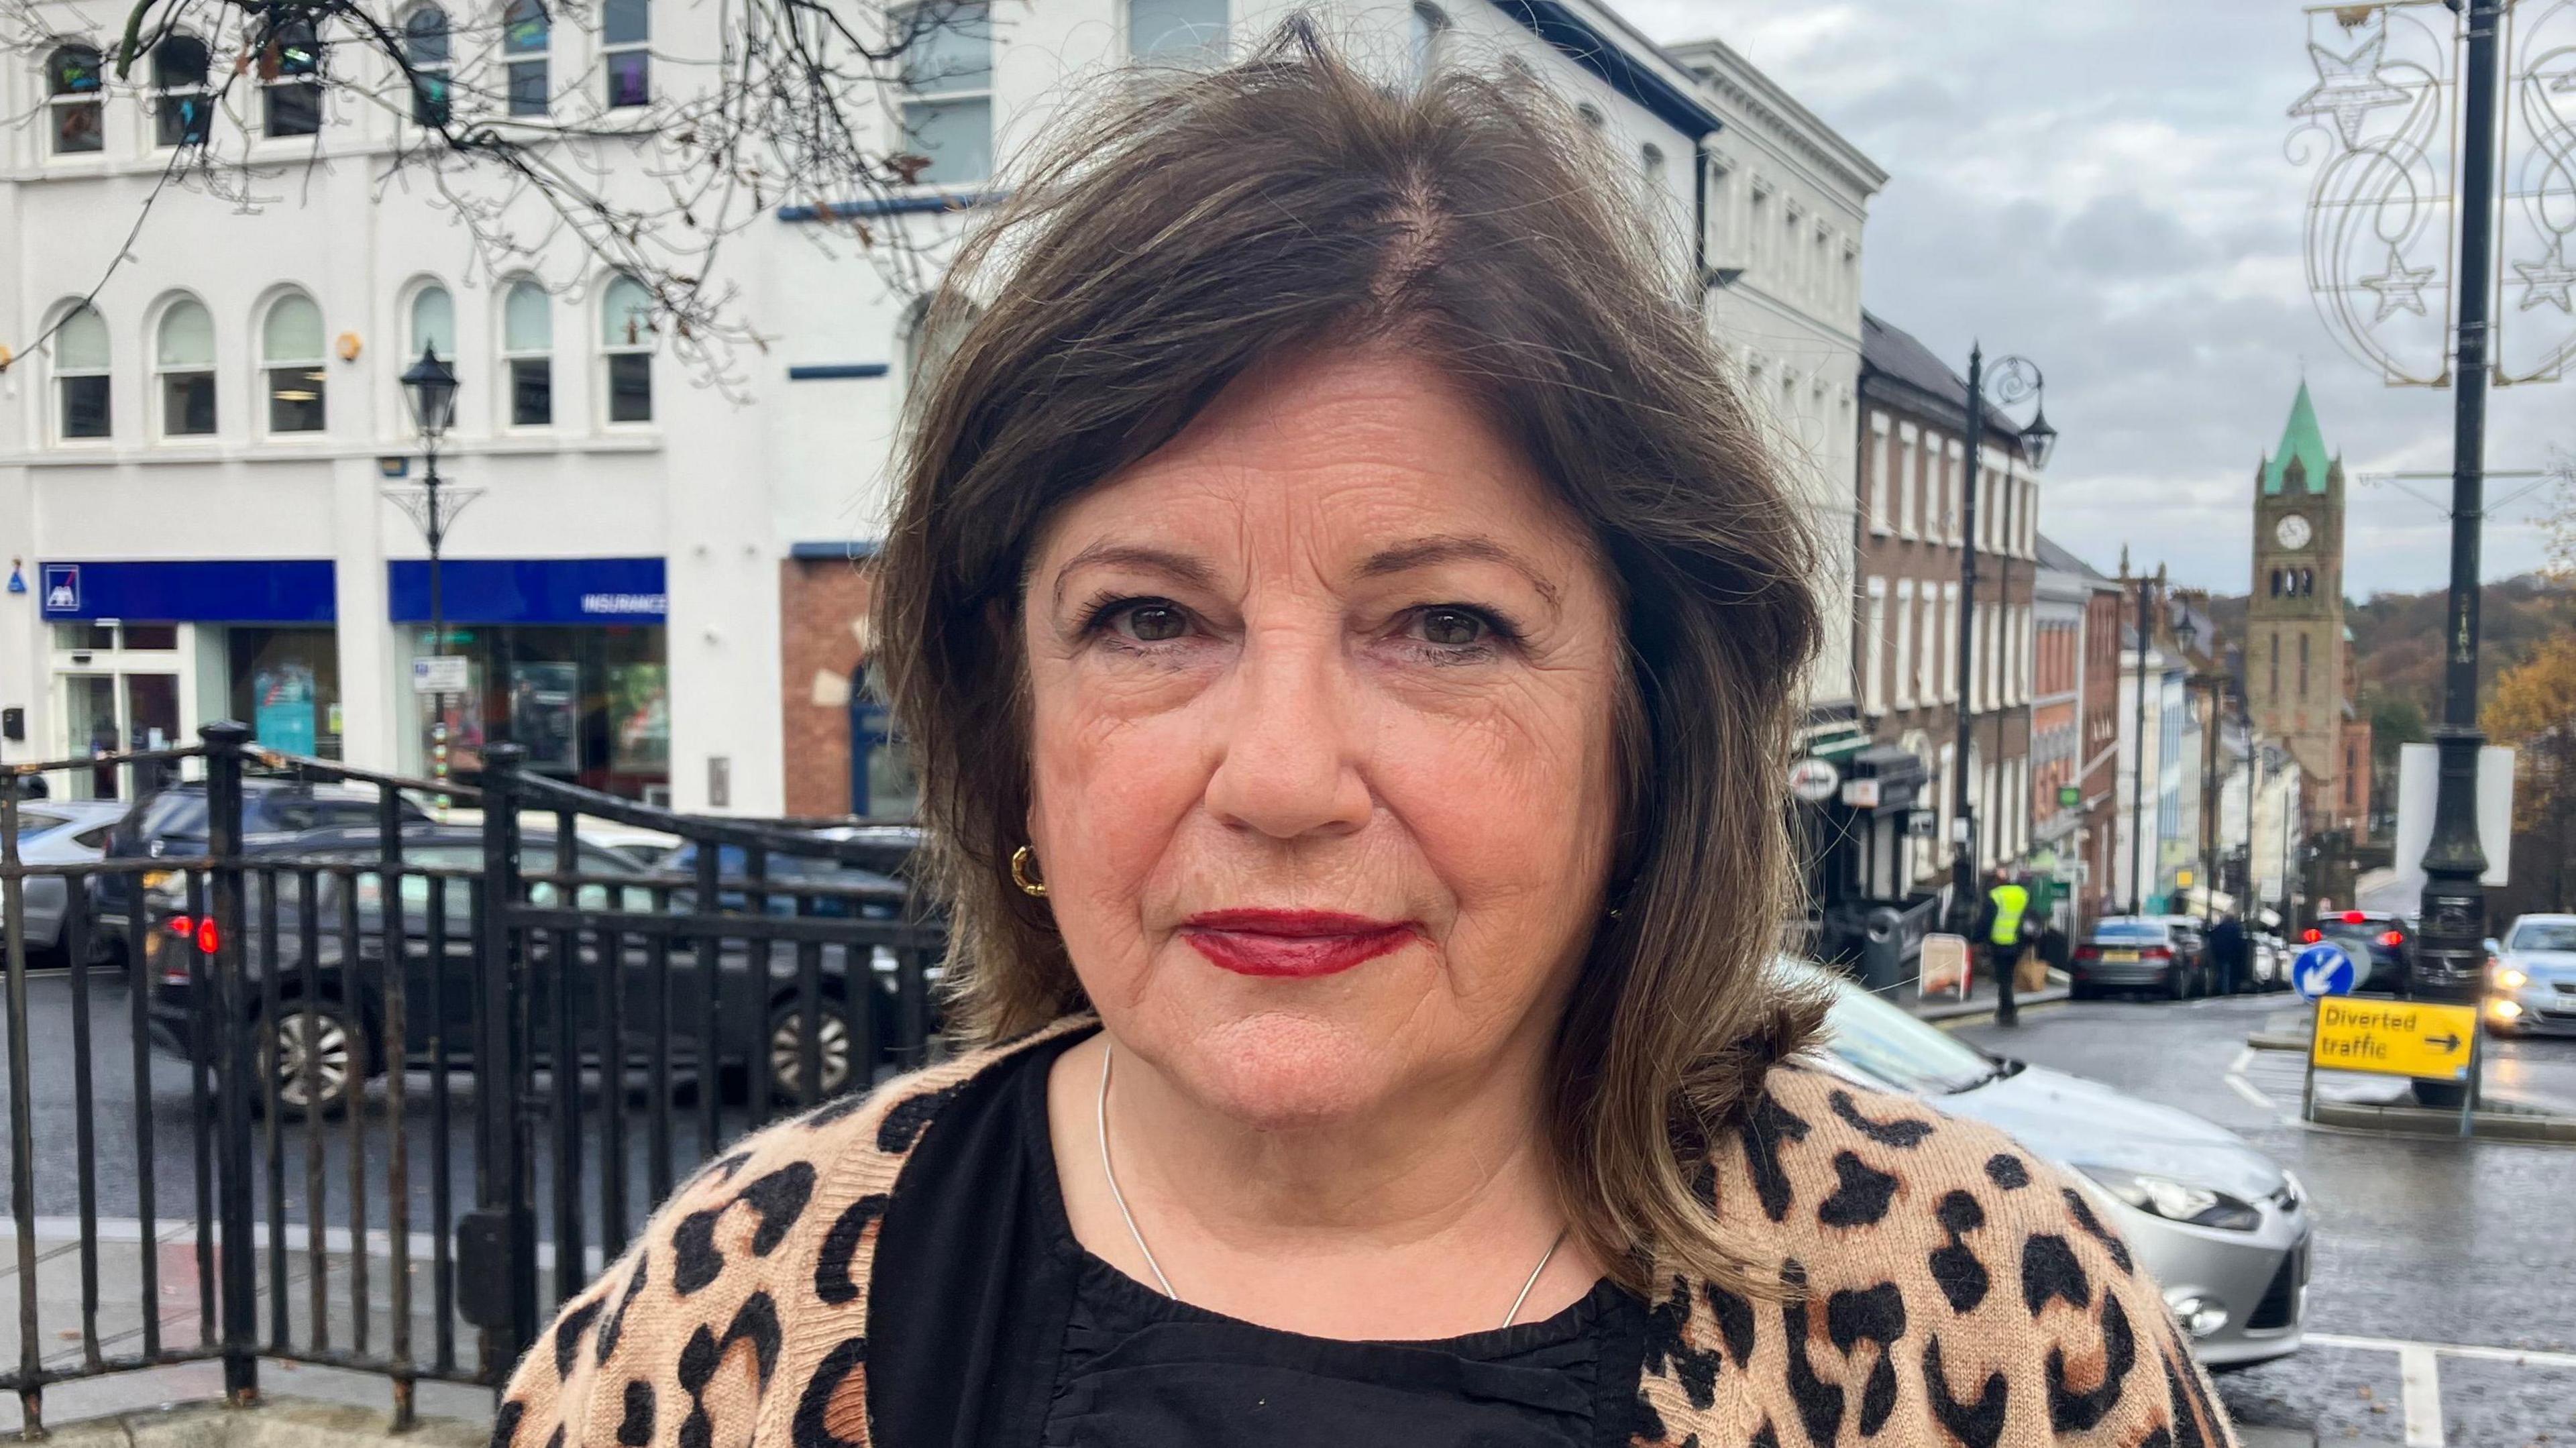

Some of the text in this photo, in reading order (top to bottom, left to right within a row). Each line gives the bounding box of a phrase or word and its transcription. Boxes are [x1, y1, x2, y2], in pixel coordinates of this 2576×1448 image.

[581, 594, 667, 614] INSURANCE
[2325, 1006, 2417, 1032] Diverted
[2322, 1033, 2387, 1060] traffic
